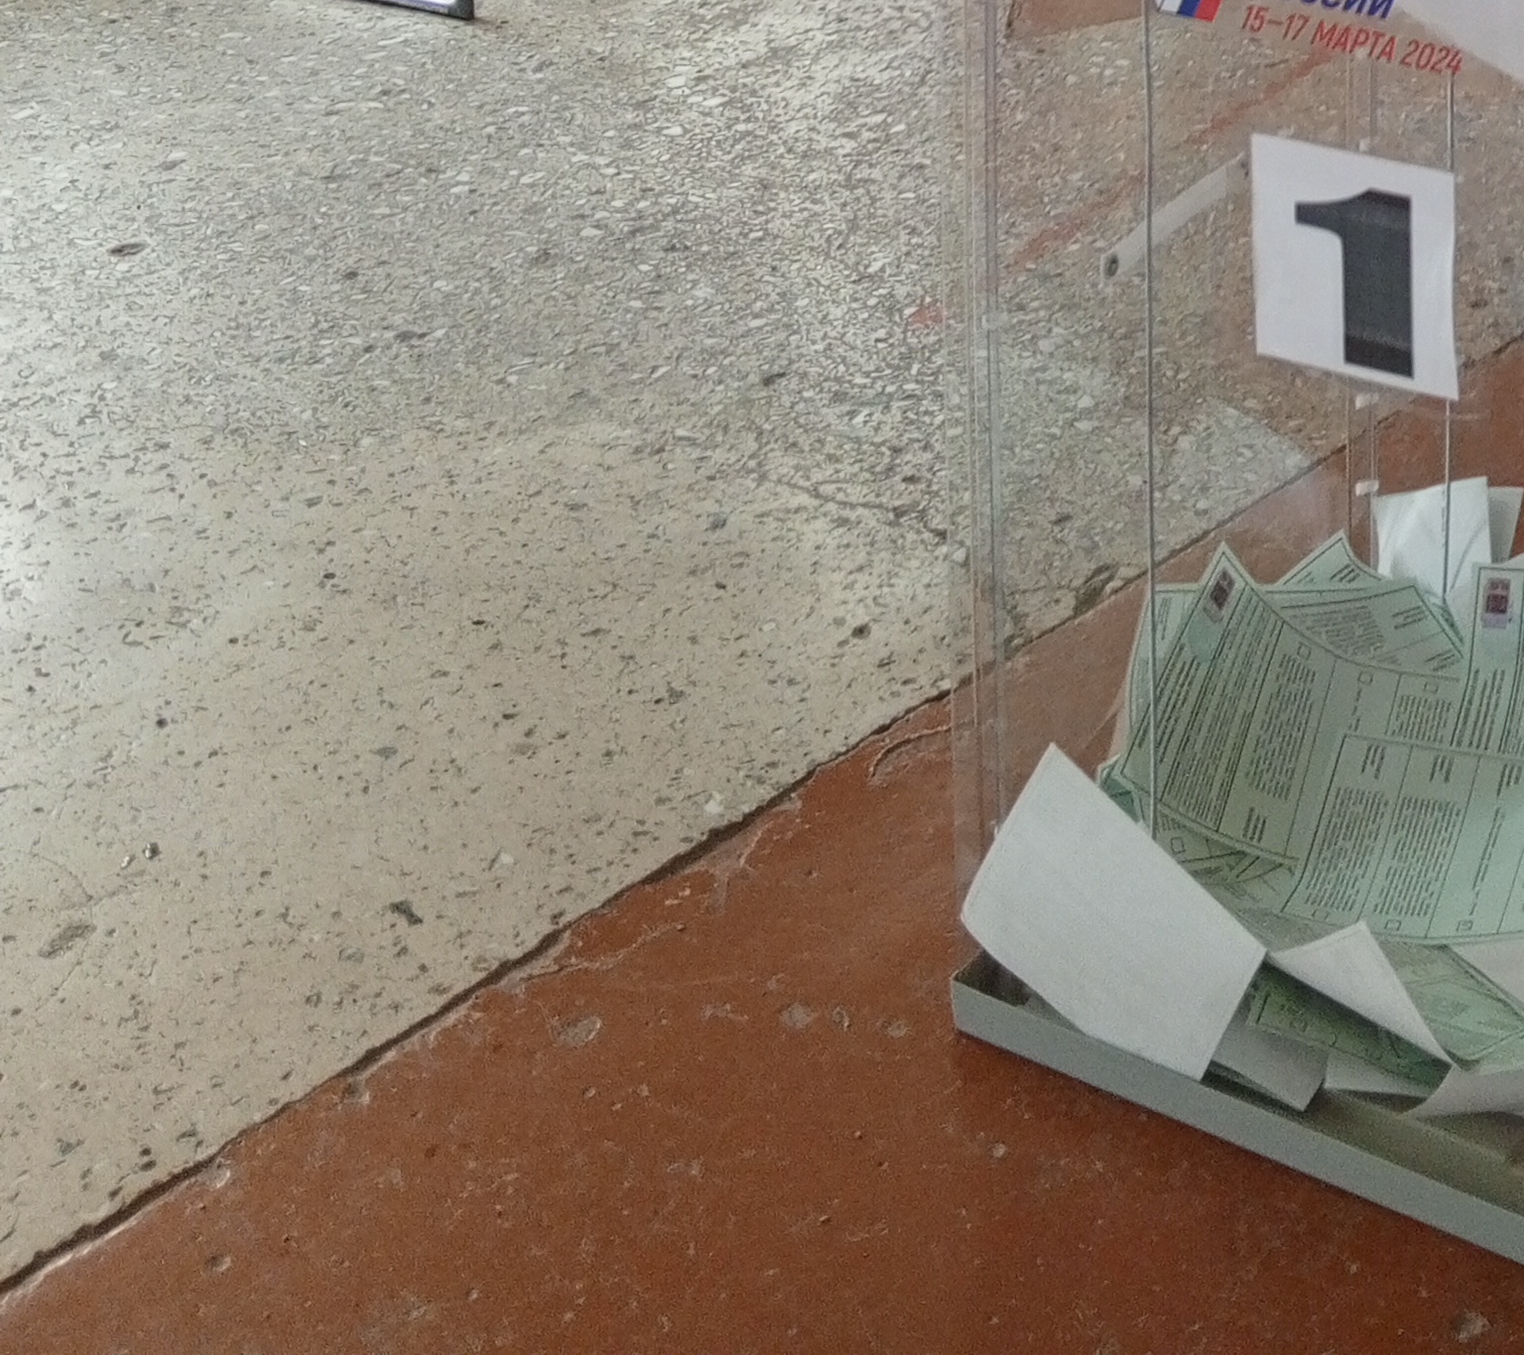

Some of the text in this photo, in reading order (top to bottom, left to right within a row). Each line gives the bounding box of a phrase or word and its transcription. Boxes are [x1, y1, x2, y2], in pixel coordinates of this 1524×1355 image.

[1311, 22, 1398, 64] МАРТА
[1400, 38, 1464, 76] 2024
[1294, 187, 1415, 380] 1
